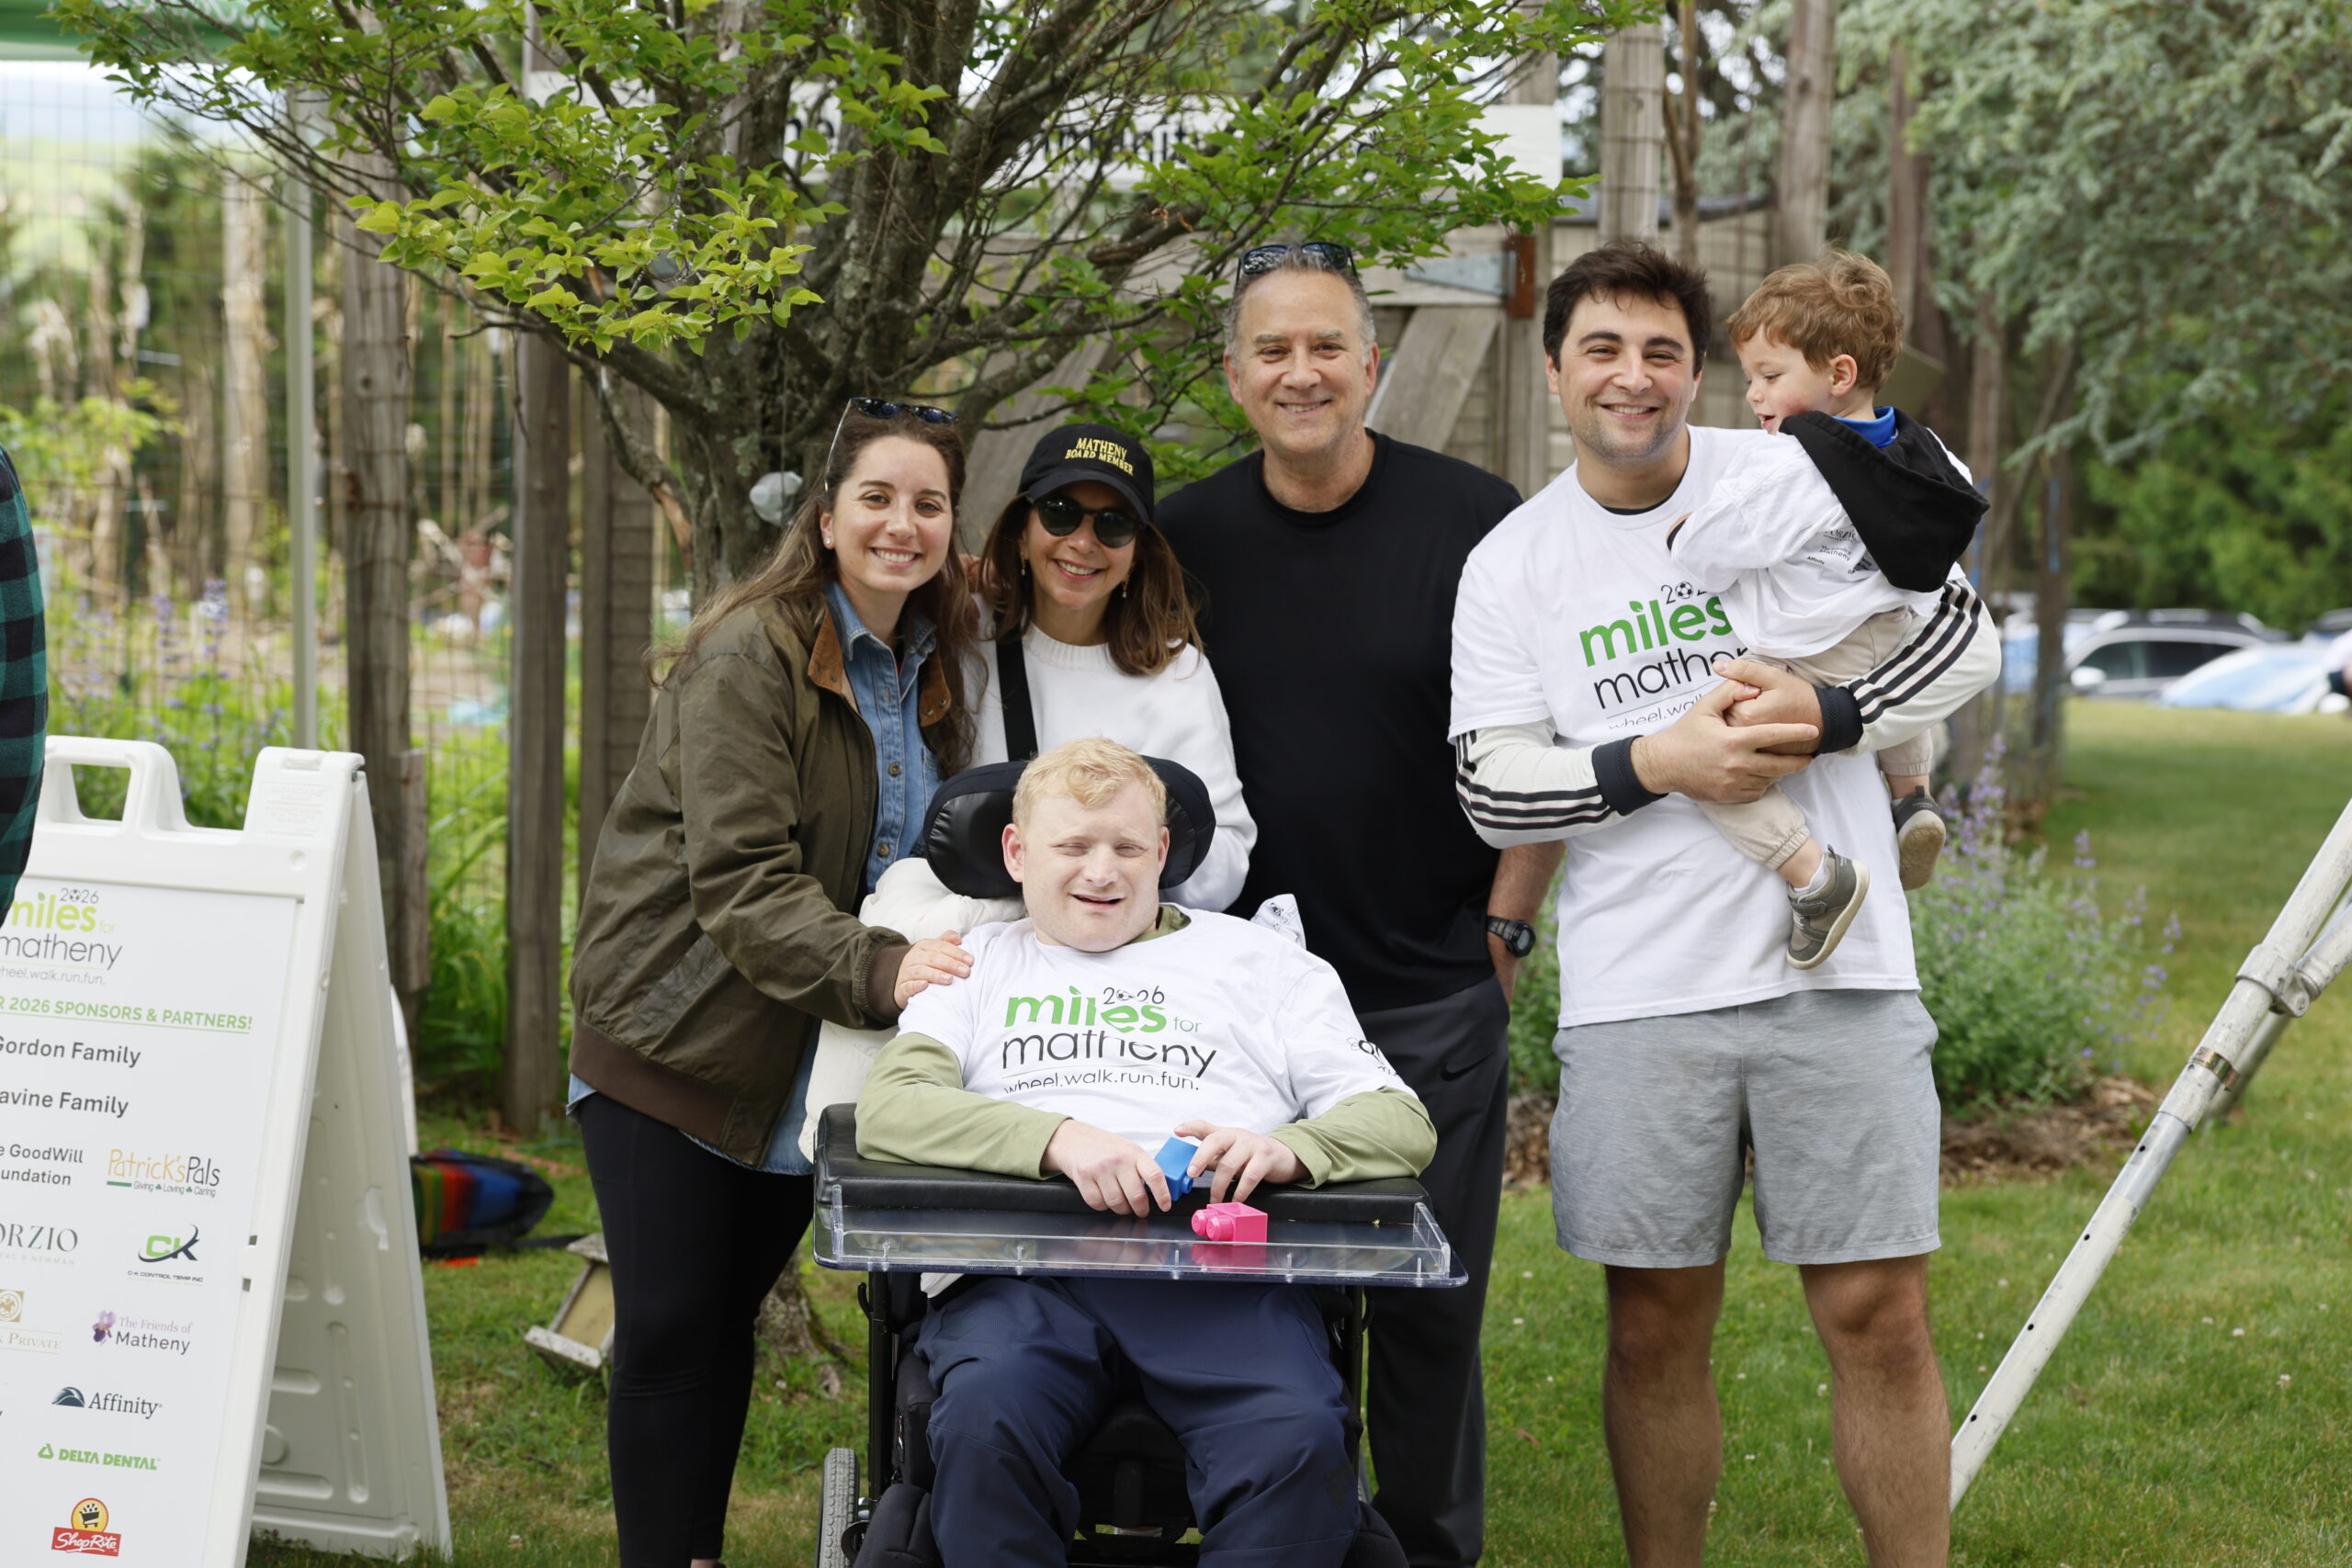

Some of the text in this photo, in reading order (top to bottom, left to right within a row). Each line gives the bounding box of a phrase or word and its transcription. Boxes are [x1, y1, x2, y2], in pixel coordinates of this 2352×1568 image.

[1076, 437, 1127, 460] MATHENY
[1065, 448, 1134, 477] BOARD MEMBER
[1579, 595, 1733, 668] miles
[1593, 648, 1748, 709] math
[60, 887, 99, 904] 2026
[99, 920, 117, 933] for
[0, 966, 106, 986] heel.walk.run.fun.
[9, 997, 51, 1013] 2026
[55, 1000, 142, 1021] SPONSORS
[146, 1008, 157, 1021] &
[163, 1010, 253, 1030] PARTNERS!
[1004, 986, 1203, 1033] miles for
[72, 1042, 141, 1068] Family
[1002, 1030, 1217, 1078] matheny
[0, 1089, 129, 1118] avine Family
[9, 1144, 83, 1163] GoodWill
[1, 1168, 72, 1186] undation
[133, 1180, 216, 1198] Giving Loving Caring
[0, 1223, 78, 1252] RZIO
[140, 1271, 171, 1280] CONTROL
[119, 1315, 194, 1334] The Friends of
[116, 1330, 190, 1356] Matheny
[88, 1392, 159, 1420] Affinity
[59, 1449, 157, 1471] DELTA DENTAL
[54, 1531, 118, 1552] ShopRite
